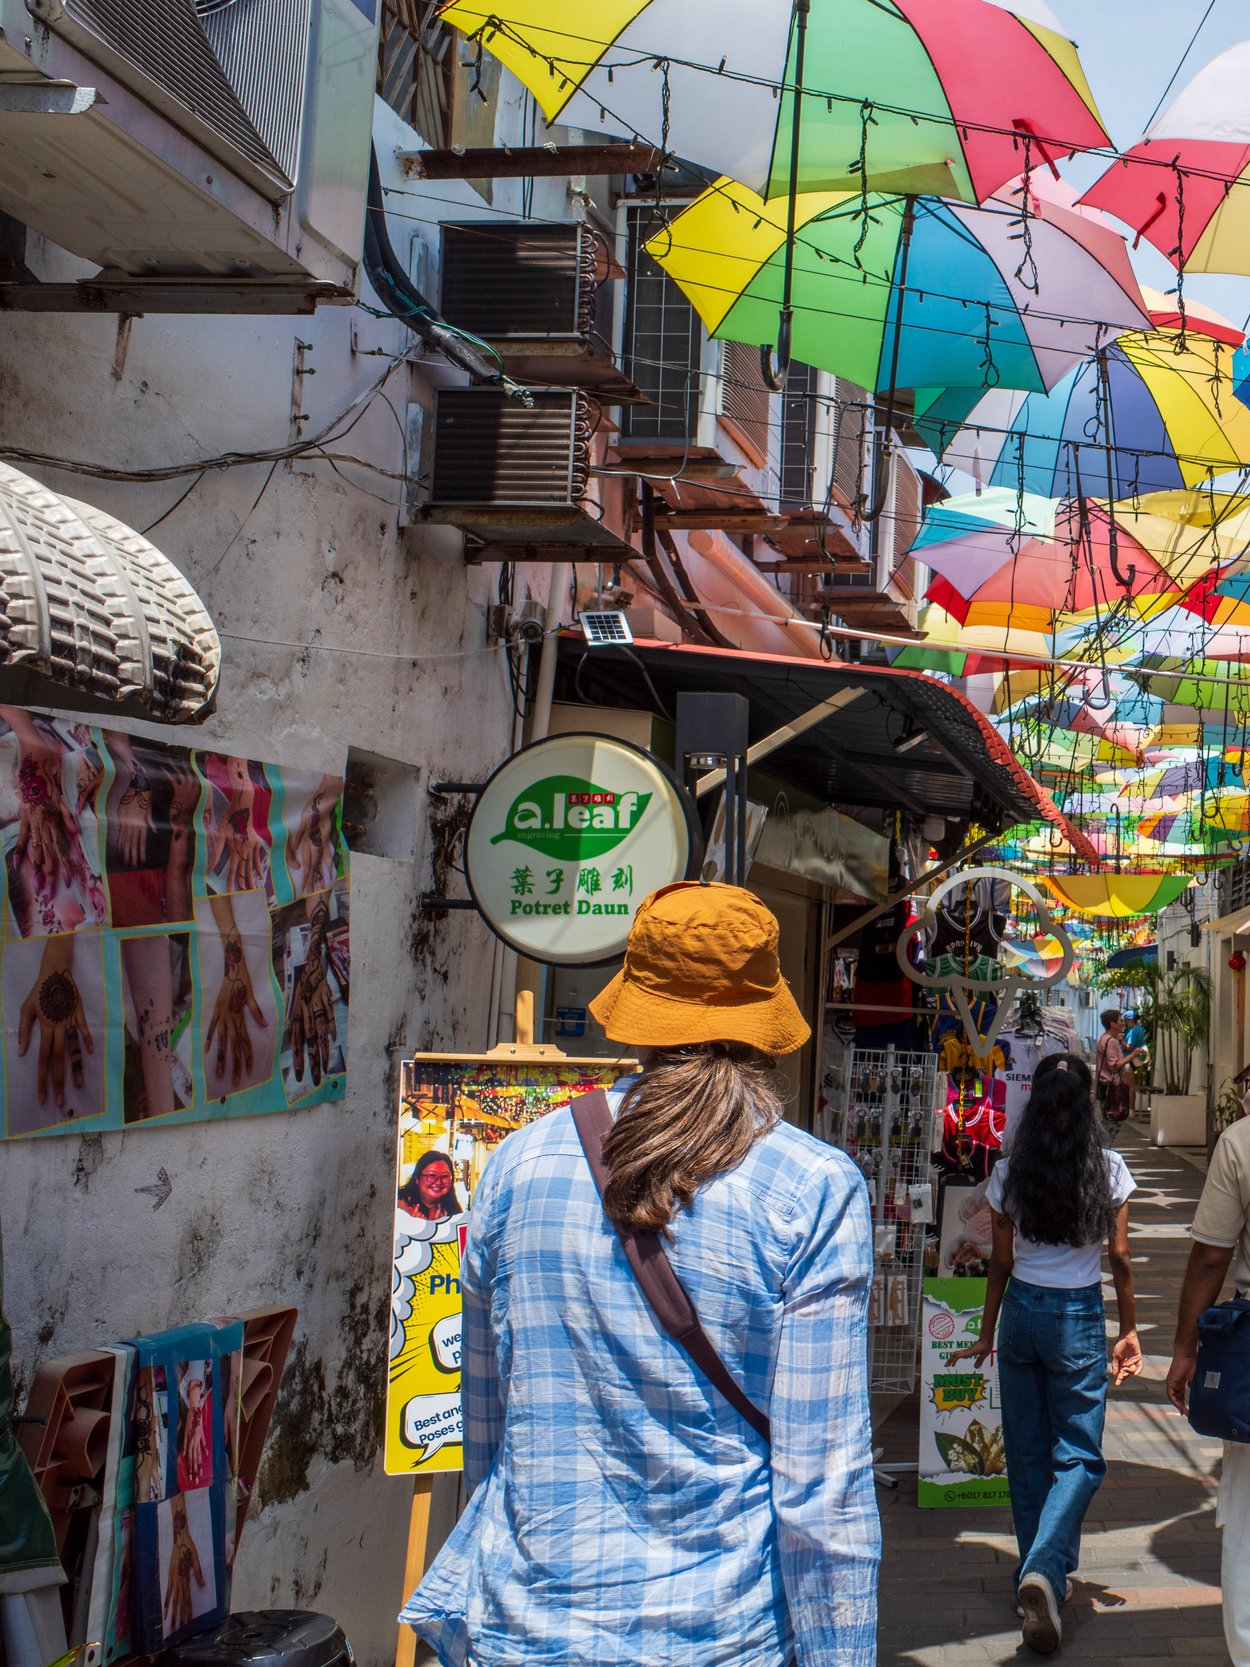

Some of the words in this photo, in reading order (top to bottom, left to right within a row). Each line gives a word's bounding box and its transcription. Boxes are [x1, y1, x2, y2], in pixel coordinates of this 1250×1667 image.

[517, 831, 560, 839] engraving
[510, 900, 570, 915] Potret
[576, 900, 629, 915] Daun
[1005, 1073, 1031, 1082] SIEM
[429, 1274, 462, 1295] Ph
[931, 1341, 954, 1349] BEST
[933, 1374, 984, 1387] MUST
[943, 1388, 978, 1402] BUY
[414, 1412, 442, 1431] Best
[419, 1424, 455, 1445] Poses
